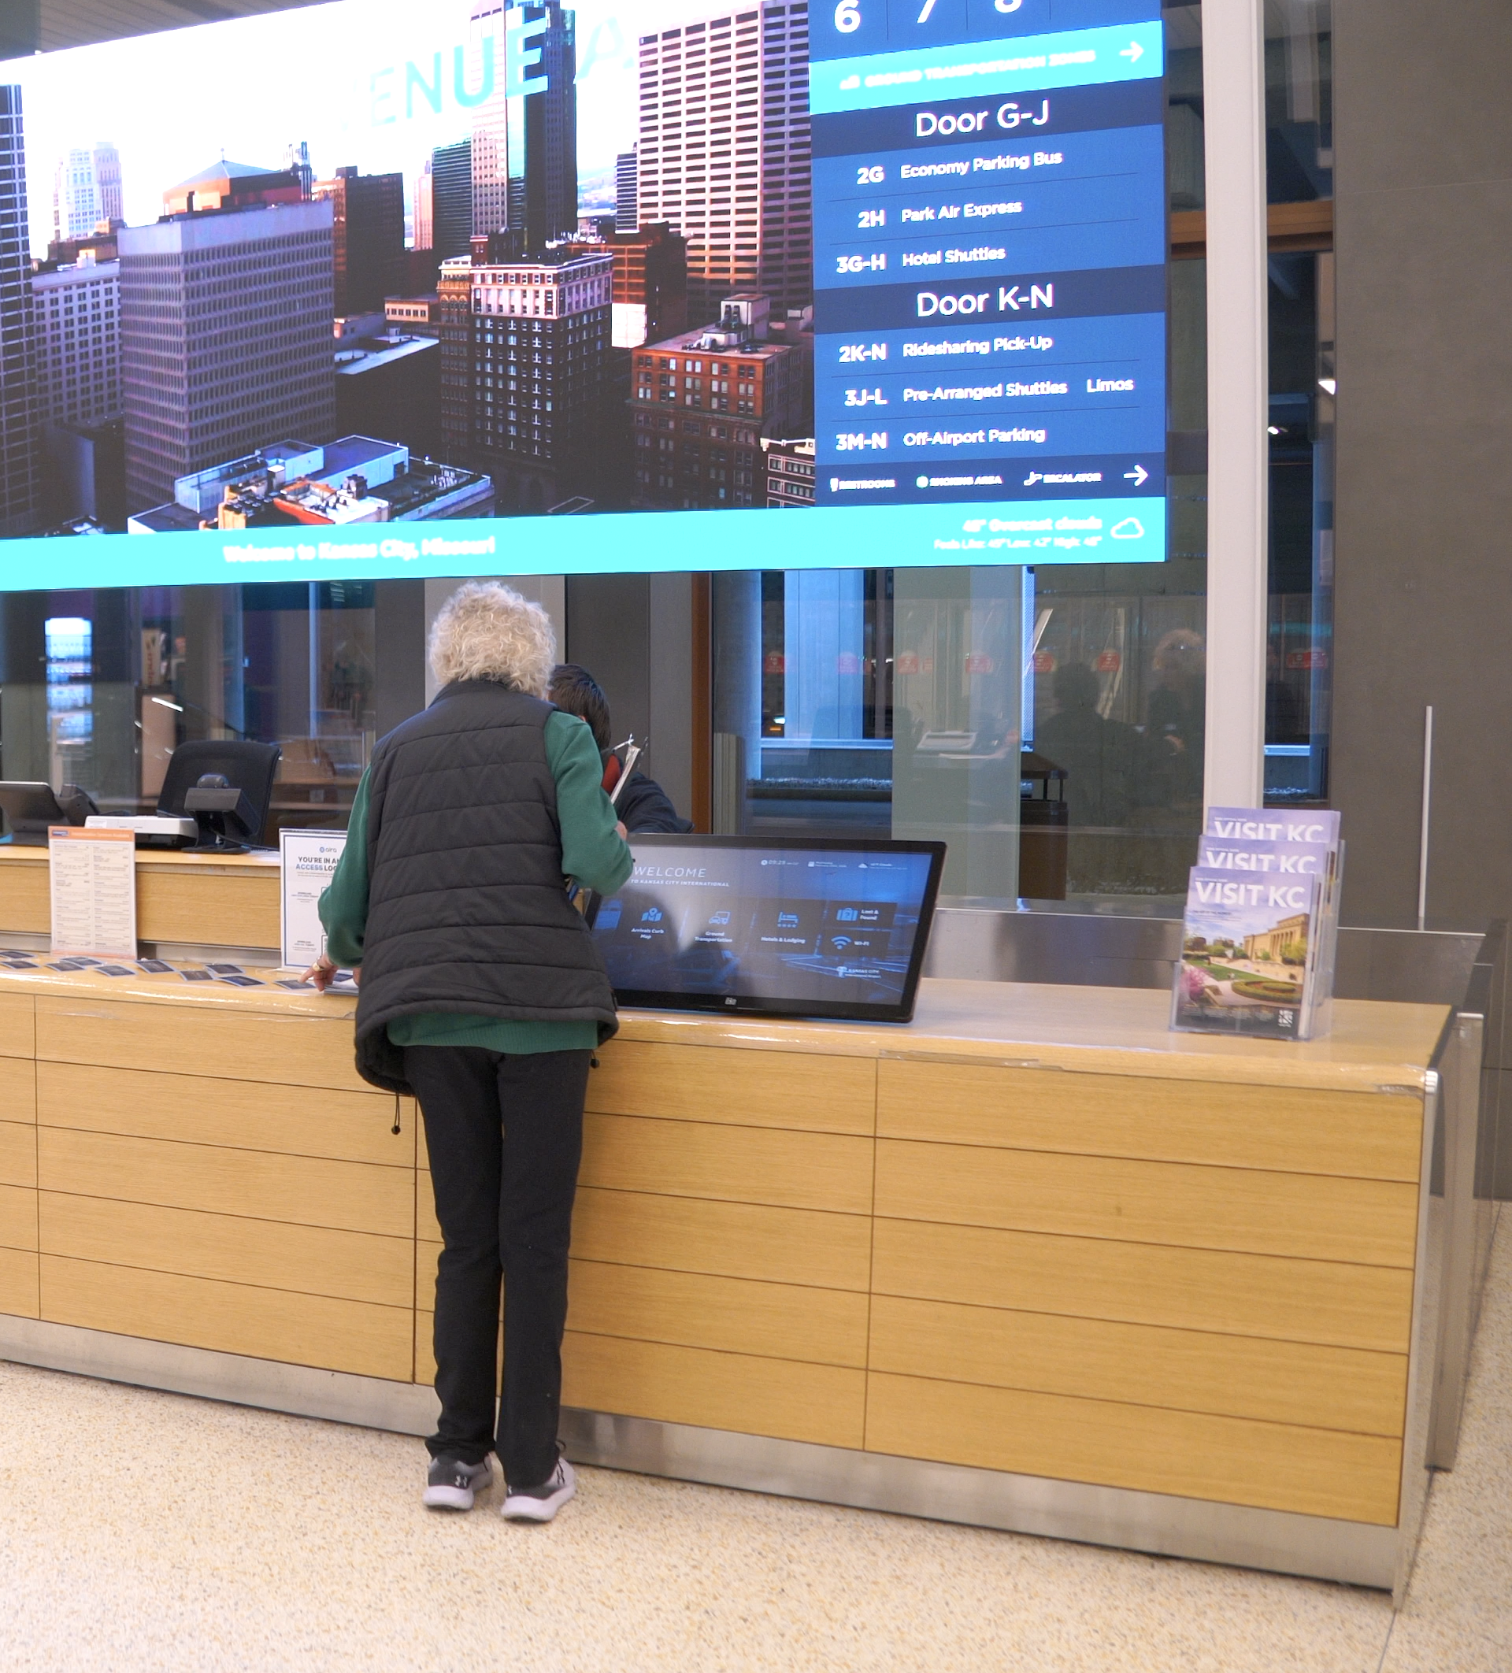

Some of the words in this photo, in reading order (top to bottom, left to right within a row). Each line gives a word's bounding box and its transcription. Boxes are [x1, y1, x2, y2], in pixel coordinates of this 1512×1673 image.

[834, 0, 861, 33] 6
[916, 110, 989, 137] Door
[997, 99, 1049, 129] G-J
[857, 165, 885, 185] 2G
[900, 161, 970, 179] Economy
[973, 155, 1031, 172] Parking
[1033, 151, 1063, 166] Bus
[858, 209, 886, 228] 2H
[901, 206, 935, 223] Park
[938, 205, 961, 219] Air
[964, 201, 1023, 218] Express
[836, 253, 886, 274] 3G-H
[902, 250, 942, 267] Hotel
[945, 246, 1006, 263] Shuttles
[917, 292, 990, 317] Door
[999, 283, 1053, 311] K-N
[839, 343, 887, 363] 2K-N
[903, 340, 991, 357] Ridesharing
[993, 335, 1053, 351] Pick-Up
[844, 388, 888, 407] 3J-L
[903, 383, 1003, 402] Pre-Arranged
[1005, 380, 1068, 397] Shuttles
[1087, 378, 1135, 393] Limos
[836, 432, 888, 451] 3M-N
[903, 429, 986, 447] Off-Airport
[988, 427, 1046, 443] Parking
[222, 543, 295, 563] Welcome
[297, 543, 317, 561] to
[317, 541, 379, 560] Kansas
[421, 535, 496, 556] Missouri
[1214, 821, 1283, 840] VISIT
[1287, 824, 1324, 843] KC
[296, 863, 323, 871] ACCESS
[298, 856, 322, 864] YOU'RE
[634, 866, 707, 878] WELCOME
[1206, 850, 1275, 872] VISIT
[1279, 854, 1317, 874] KC
[1194, 881, 1264, 906] VISIT
[1268, 886, 1306, 909] KC
